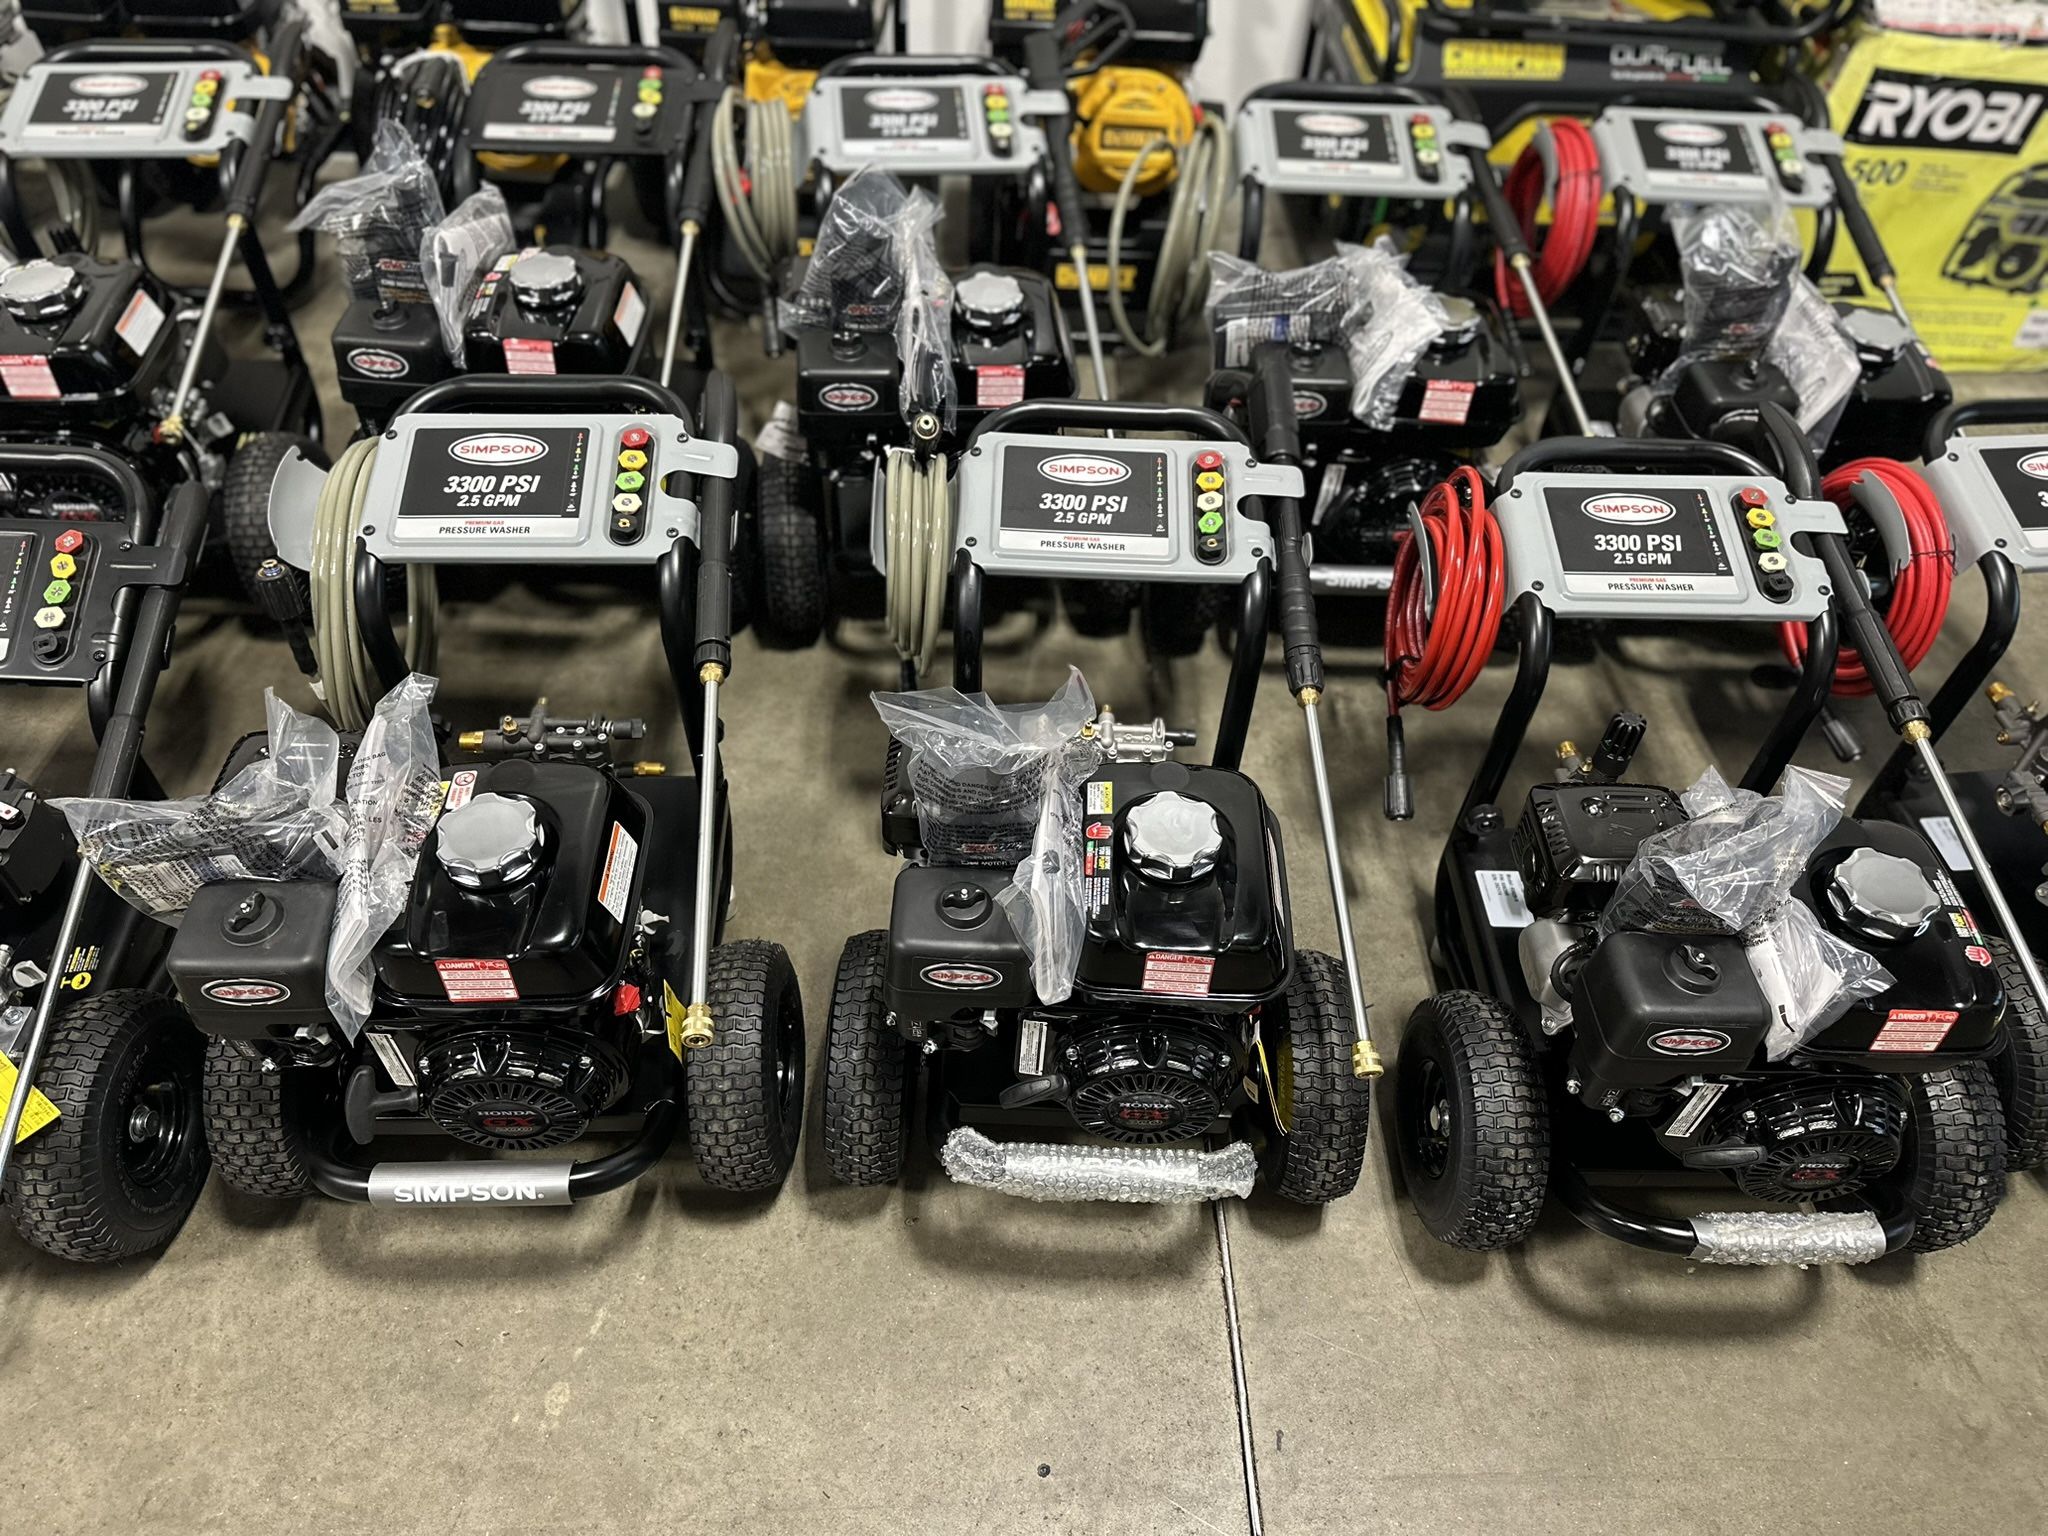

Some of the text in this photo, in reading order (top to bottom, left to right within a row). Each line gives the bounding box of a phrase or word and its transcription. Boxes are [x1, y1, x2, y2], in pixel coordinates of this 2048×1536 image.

[1858, 80, 2044, 145] RYOBI
[460, 445, 536, 454] SIMPSON
[1048, 464, 1120, 476] SIMPSON
[443, 475, 541, 493] 3300 PSI
[456, 494, 522, 507] 2.5 GPM
[1039, 492, 1128, 513] 3300 PSI
[1592, 504, 1664, 514] SIMPSON
[1053, 511, 1113, 525] 2.5 GPM
[439, 526, 530, 534] PRESSURE WASHER
[1040, 540, 1126, 551] PRESSURE WASHER
[1594, 534, 1682, 552] 3300 PSI
[1613, 552, 1672, 565] 2.5 GPM
[1608, 583, 1694, 592] PRESSURE WASHER
[932, 972, 990, 981] SIMPSON
[215, 988, 276, 997] SIMPSON
[1661, 1038, 1717, 1047] SIMPSON
